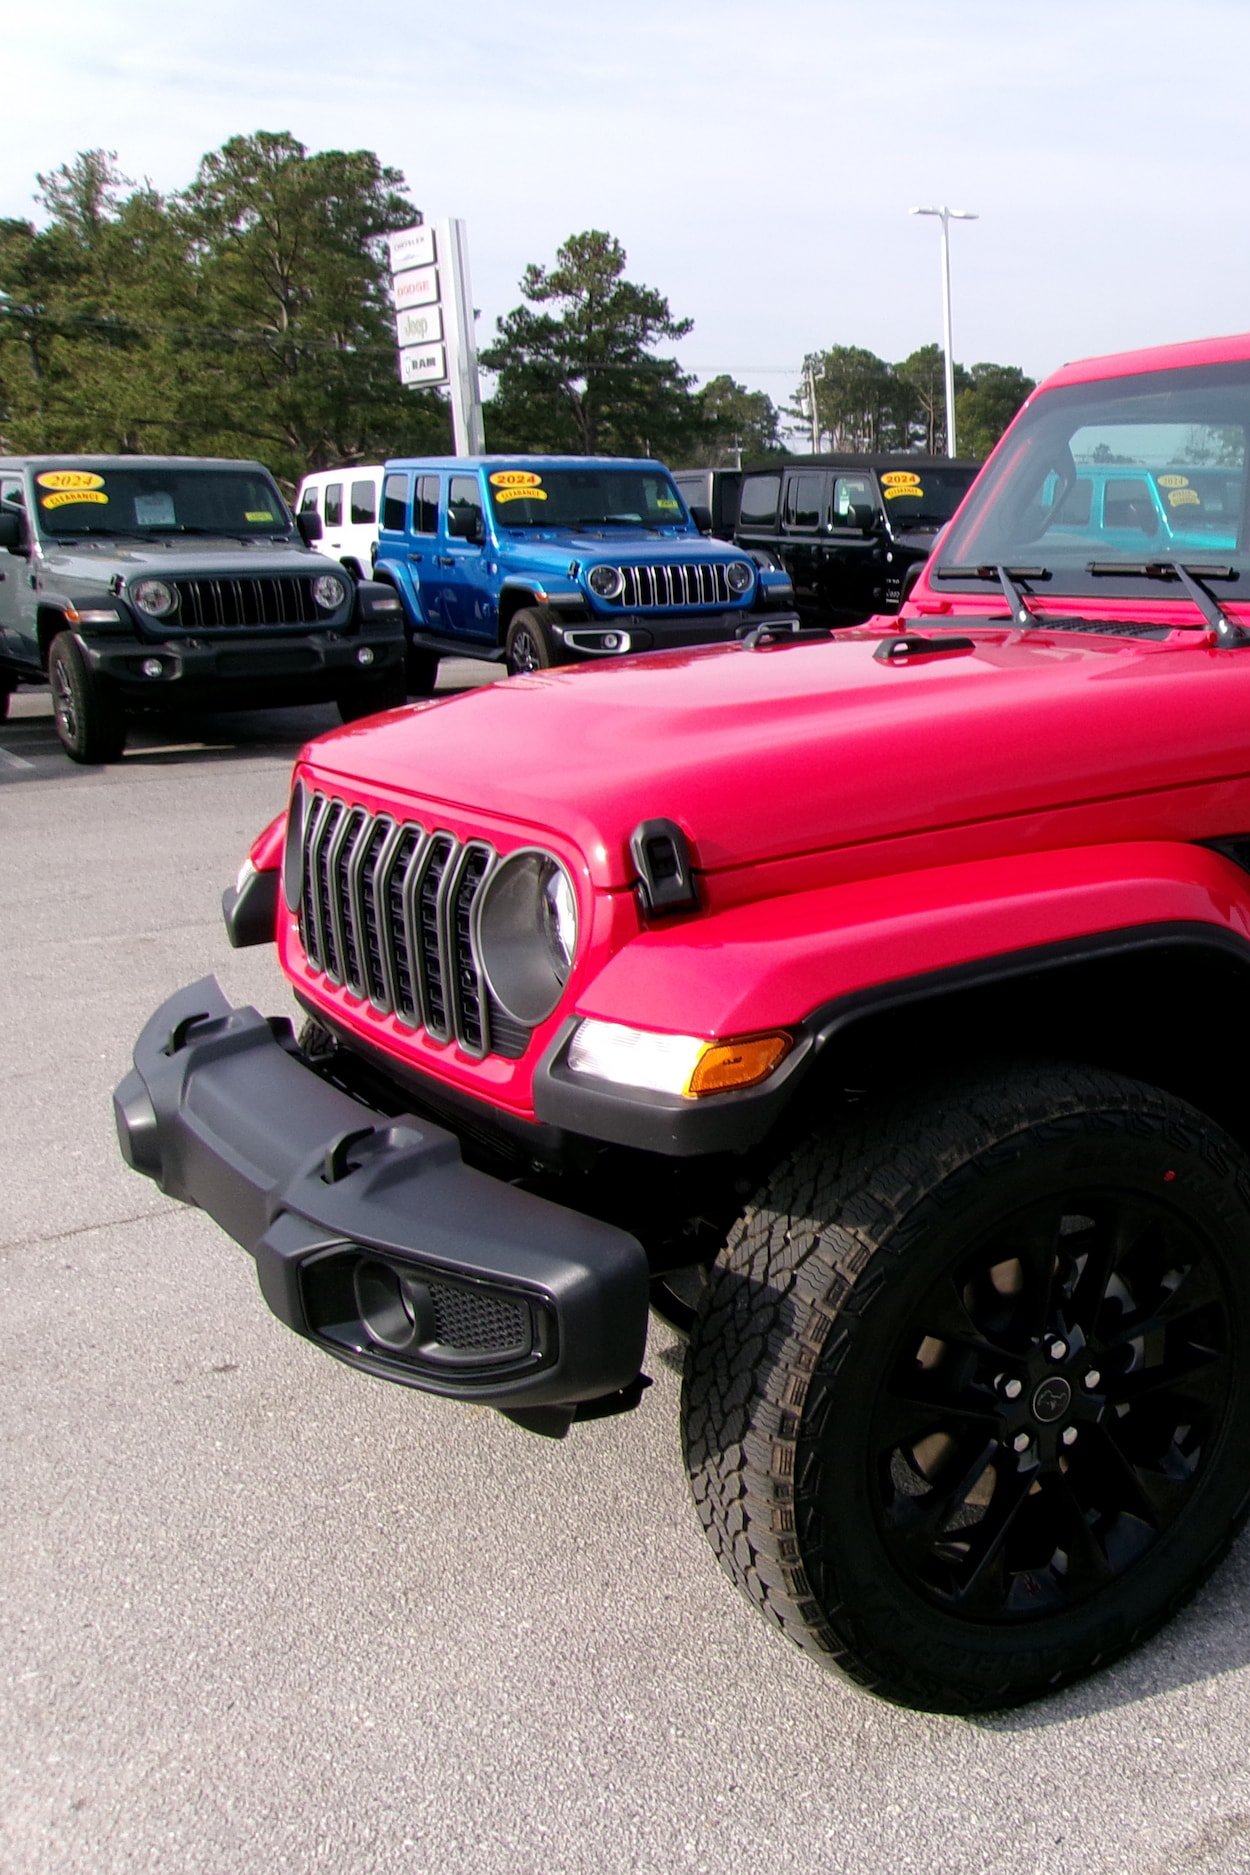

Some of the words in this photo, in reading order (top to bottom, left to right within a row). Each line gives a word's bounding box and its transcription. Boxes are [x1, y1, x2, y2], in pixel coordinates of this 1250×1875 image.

[397, 279, 430, 297] DODGE
[405, 314, 428, 339] Jeep
[412, 357, 436, 370] RAM
[51, 475, 93, 486] 2024
[497, 475, 535, 484] 2024
[886, 475, 916, 484] 2024
